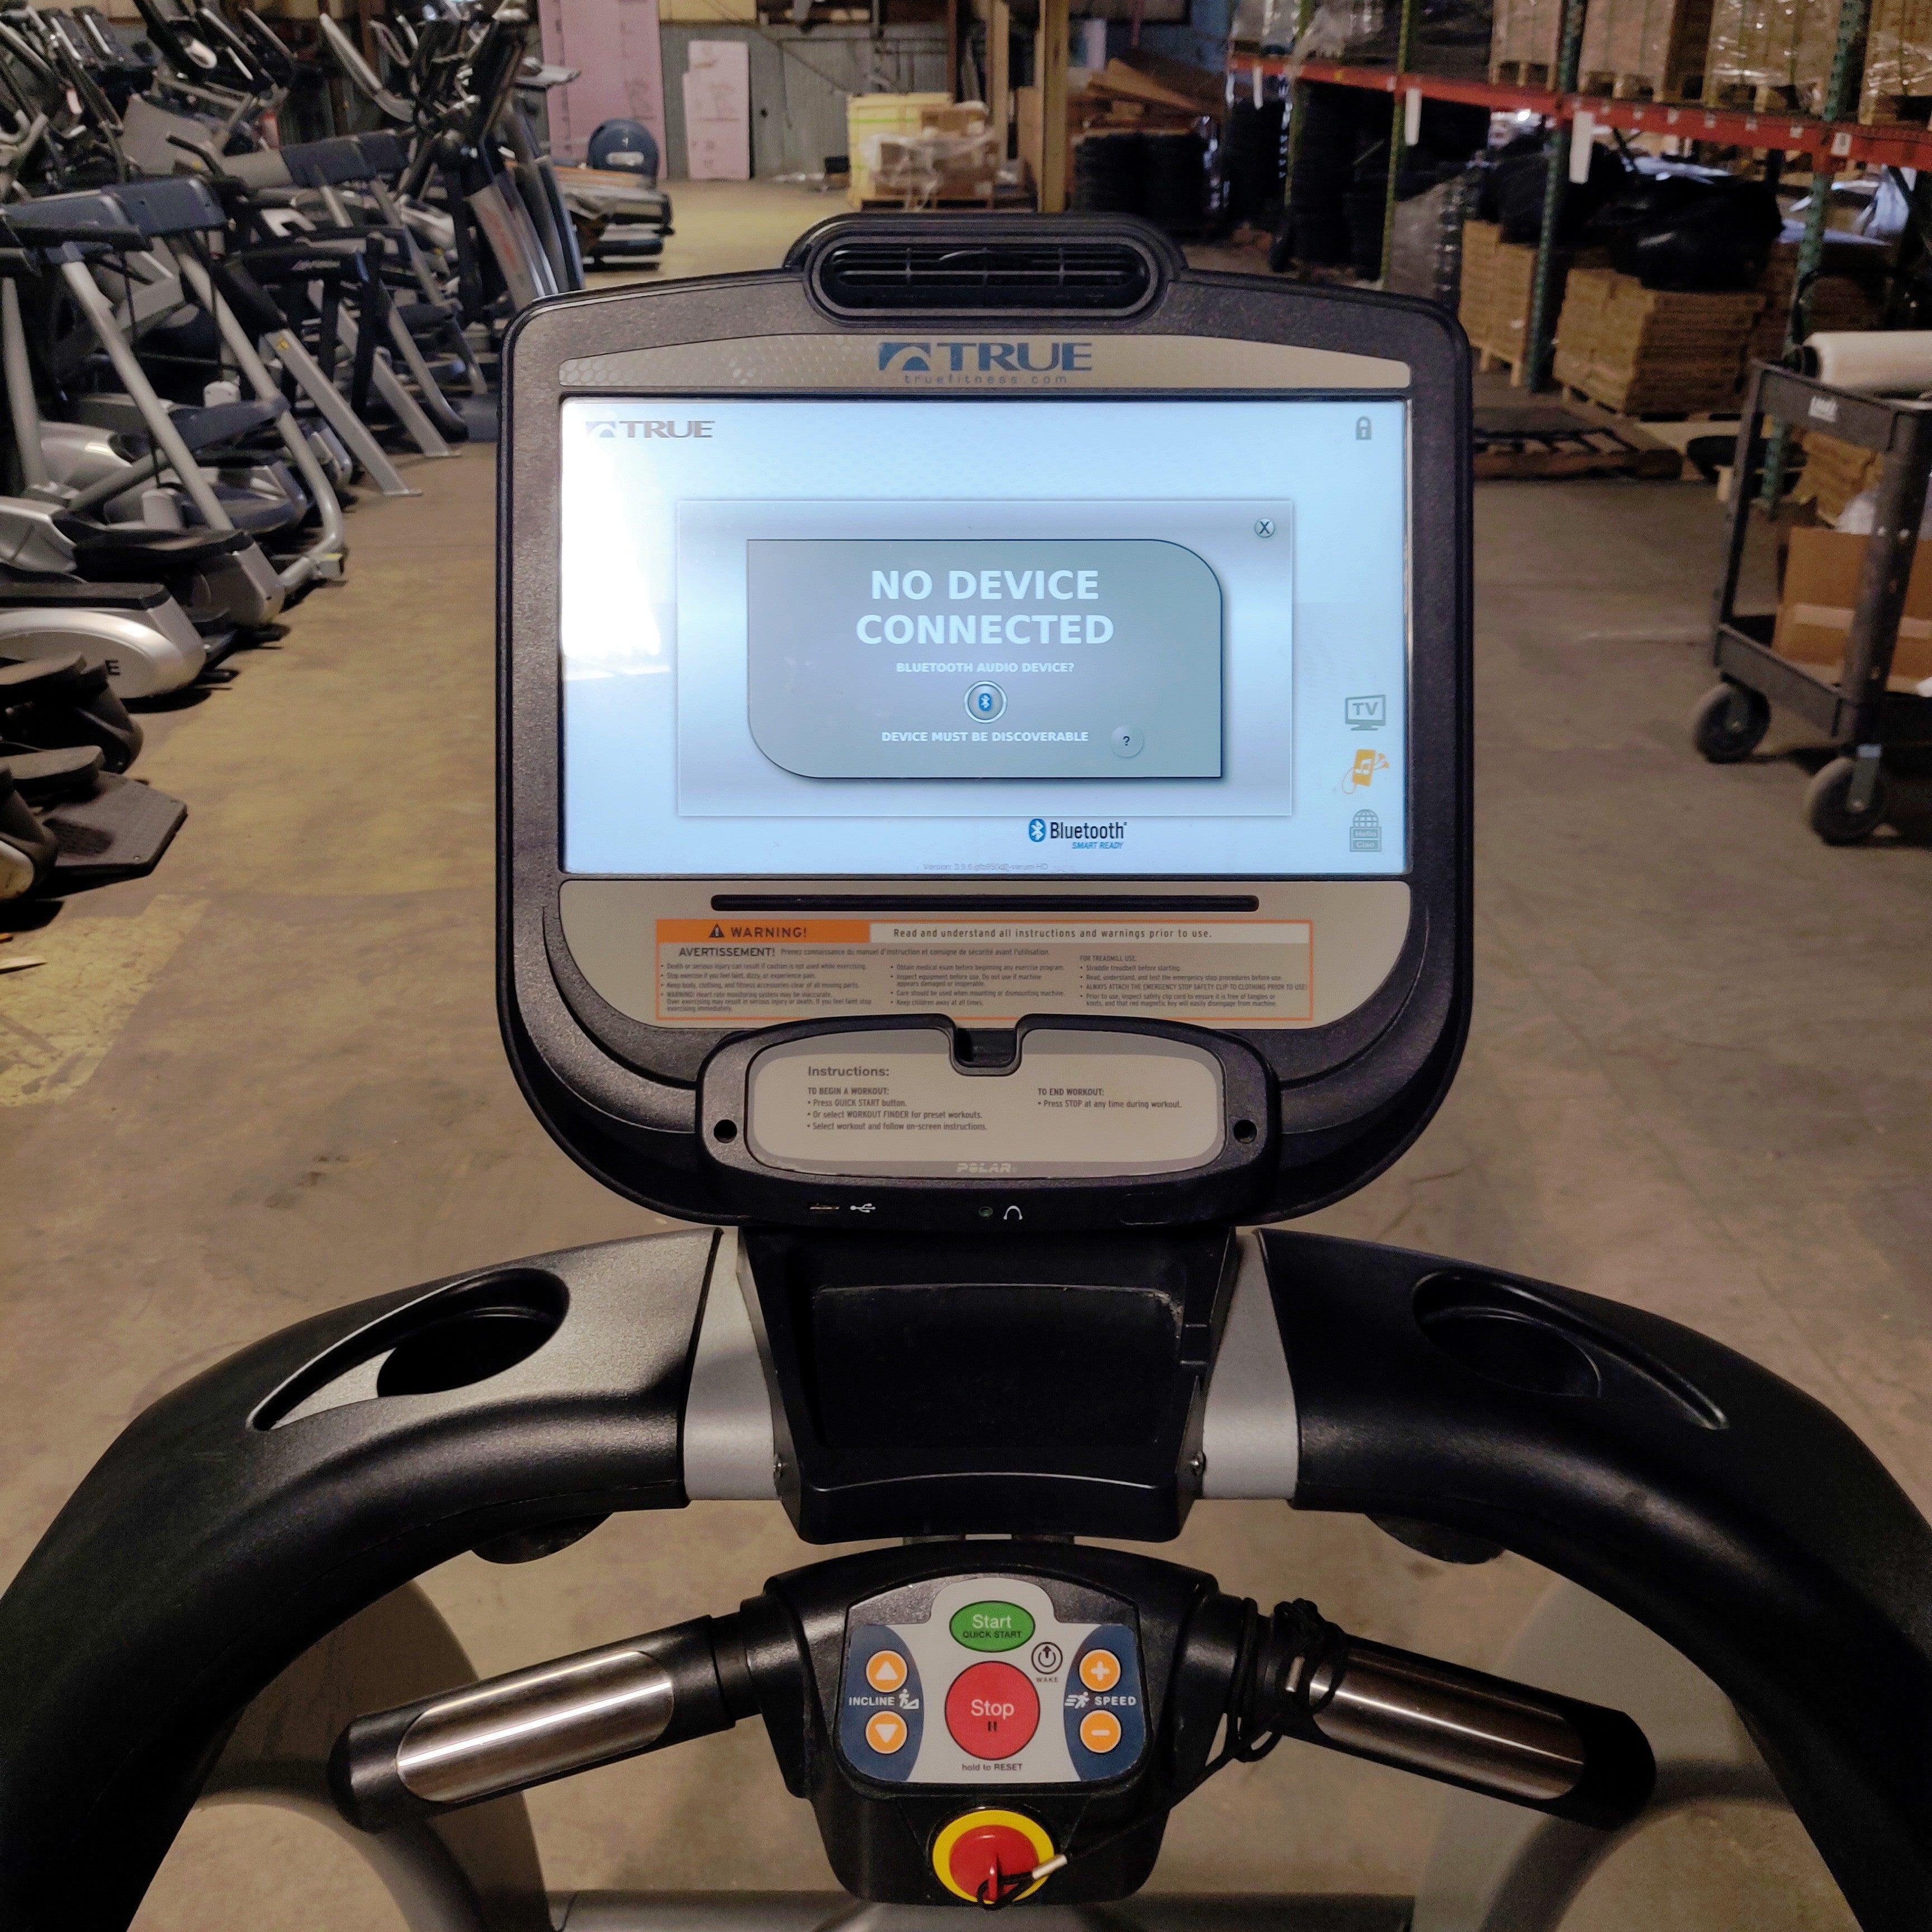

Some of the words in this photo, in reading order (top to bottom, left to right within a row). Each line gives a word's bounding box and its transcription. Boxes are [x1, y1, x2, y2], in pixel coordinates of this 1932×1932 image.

[937, 343, 1092, 371] TRUE
[905, 375, 1067, 384] truefitness.com
[619, 420, 715, 438] TRUE
[872, 570, 932, 599] NO
[948, 570, 1099, 599] DEVICE
[856, 614, 1114, 644] CONNECTED
[896, 662, 973, 673] BLUETOOTH
[976, 662, 1019, 673] AUDIO
[1022, 662, 1075, 673] DEVICE?
[1352, 702, 1379, 716] TV
[882, 732, 928, 742] DEVICE
[932, 732, 969, 742] MUST
[972, 732, 988, 742] BE
[992, 732, 1089, 742] DISCOVERABLE
[1050, 822, 1125, 839] Bluetooth
[731, 927, 807, 937] WARNING!
[894, 929, 917, 937] Read
[921, 929, 937, 937] and
[941, 929, 996, 937] understand
[999, 929, 1011, 937] all
[1015, 929, 1076, 937] instructions
[1079, 929, 1097, 937] and
[1101, 929, 1145, 940] warnings
[1149, 929, 1173, 940] prior
[1178, 929, 1187, 937] to
[679, 948, 775, 956] AVERTISSEMENT!
[808, 1067, 889, 1076] Instructions:
[813, 1098, 832, 1107] Press
[858, 1098, 879, 1107] START
[924, 1111, 946, 1119] preset
[972, 1614, 1012, 1629] Start
[963, 1631, 992, 1639] QUICK
[994, 1631, 1022, 1639] START
[849, 1697, 895, 1706] INCLINE
[1095, 1696, 1137, 1706] SPEED
[970, 1699, 1015, 1720] Stop
